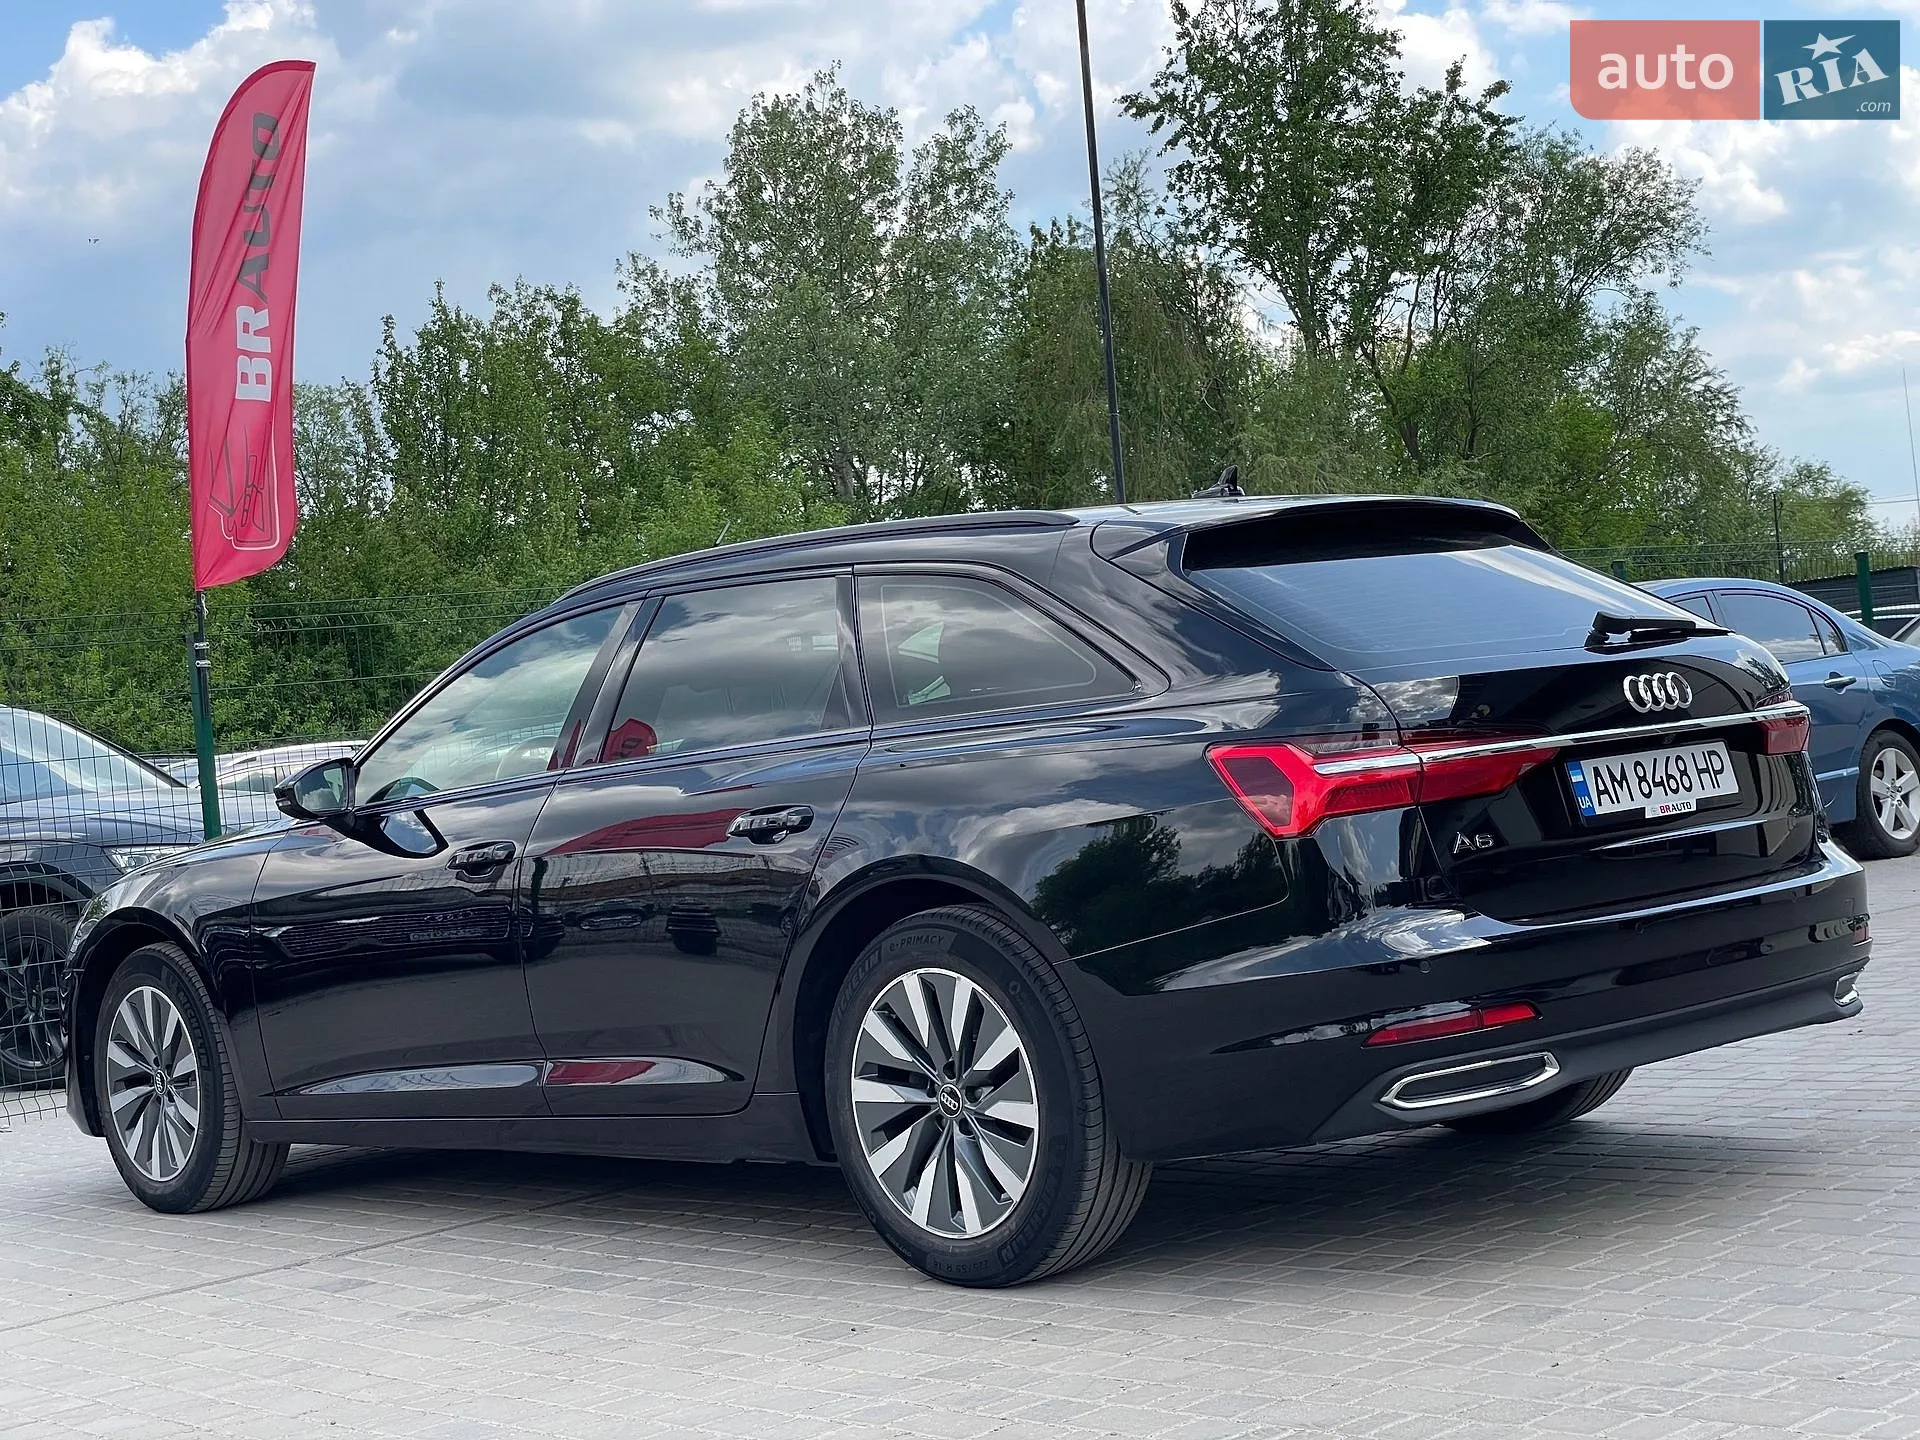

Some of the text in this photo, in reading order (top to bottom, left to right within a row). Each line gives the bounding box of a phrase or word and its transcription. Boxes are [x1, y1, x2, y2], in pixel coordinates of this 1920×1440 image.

[233, 111, 282, 403] BRAUTO
[1592, 749, 1725, 807] AM 8468 HP
[1578, 796, 1593, 809] UA
[1659, 801, 1692, 814] BRAUTO
[1452, 831, 1495, 854] A6
